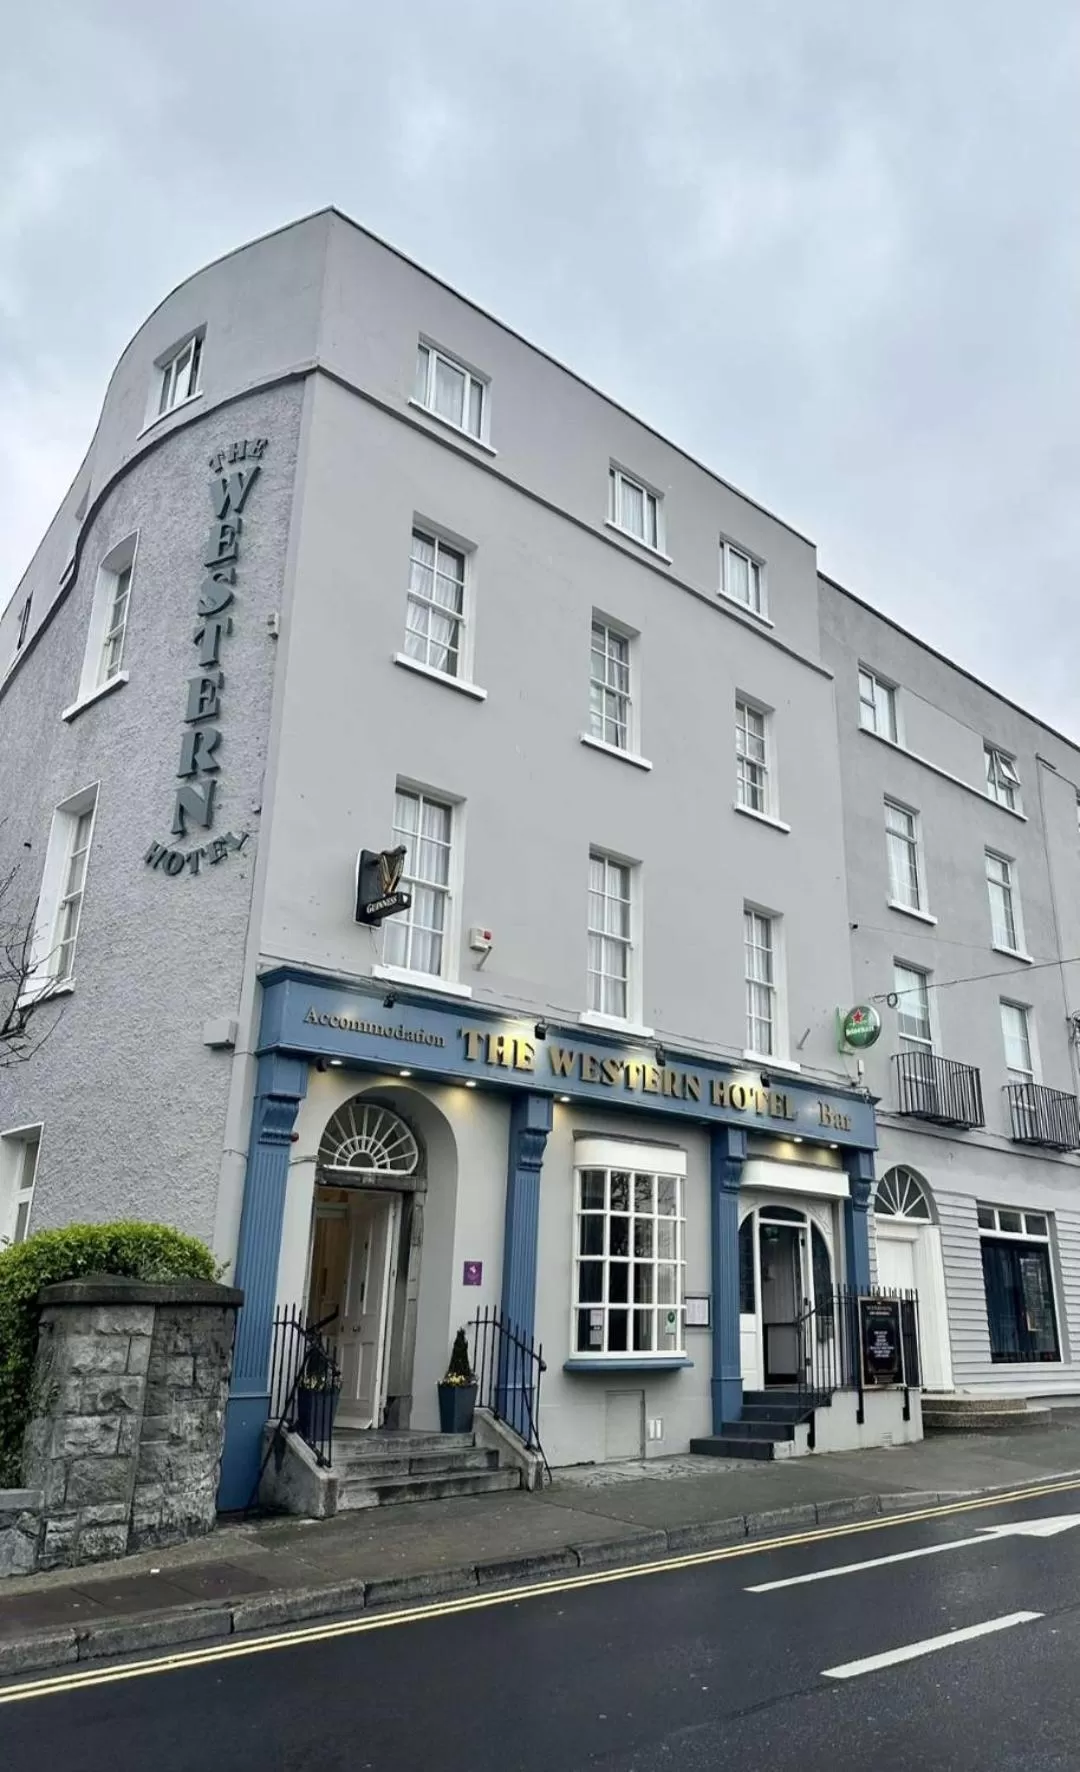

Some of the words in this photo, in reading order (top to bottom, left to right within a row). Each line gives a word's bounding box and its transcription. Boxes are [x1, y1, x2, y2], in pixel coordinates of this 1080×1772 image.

[208, 438, 269, 473] THE
[171, 465, 263, 836] WESTERN
[143, 831, 250, 876] HOTEL
[303, 1005, 445, 1048] Accommodation
[457, 1025, 535, 1072] THE
[548, 1045, 700, 1103] WESTERN
[708, 1078, 797, 1121] HOTEL
[818, 1098, 851, 1131] Bar
